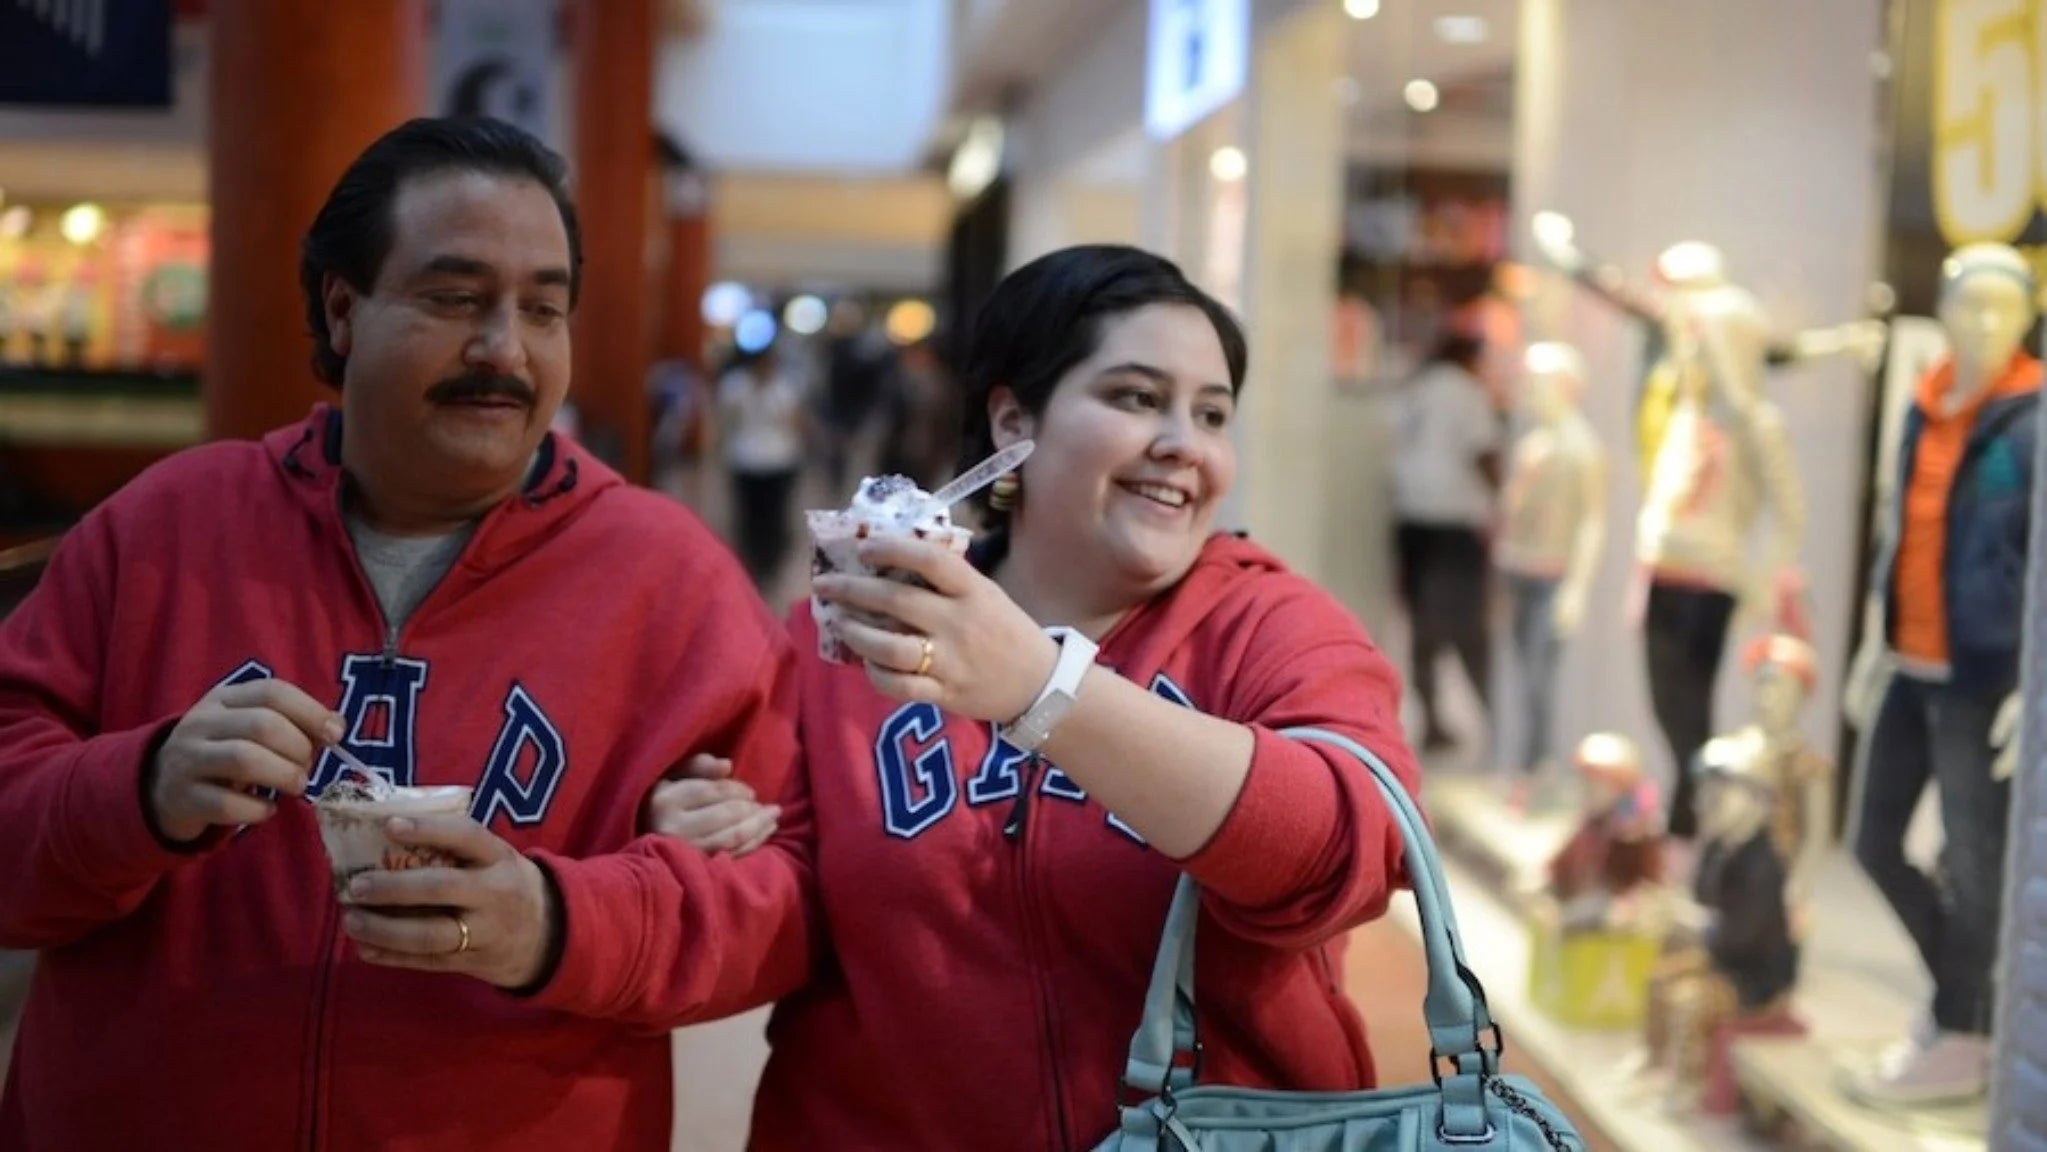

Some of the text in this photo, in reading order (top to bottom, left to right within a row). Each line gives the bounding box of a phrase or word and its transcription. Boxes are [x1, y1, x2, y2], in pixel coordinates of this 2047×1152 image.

[1943, 0, 2047, 232] 5
[206, 653, 566, 832] AP
[875, 671, 1197, 848] GA
